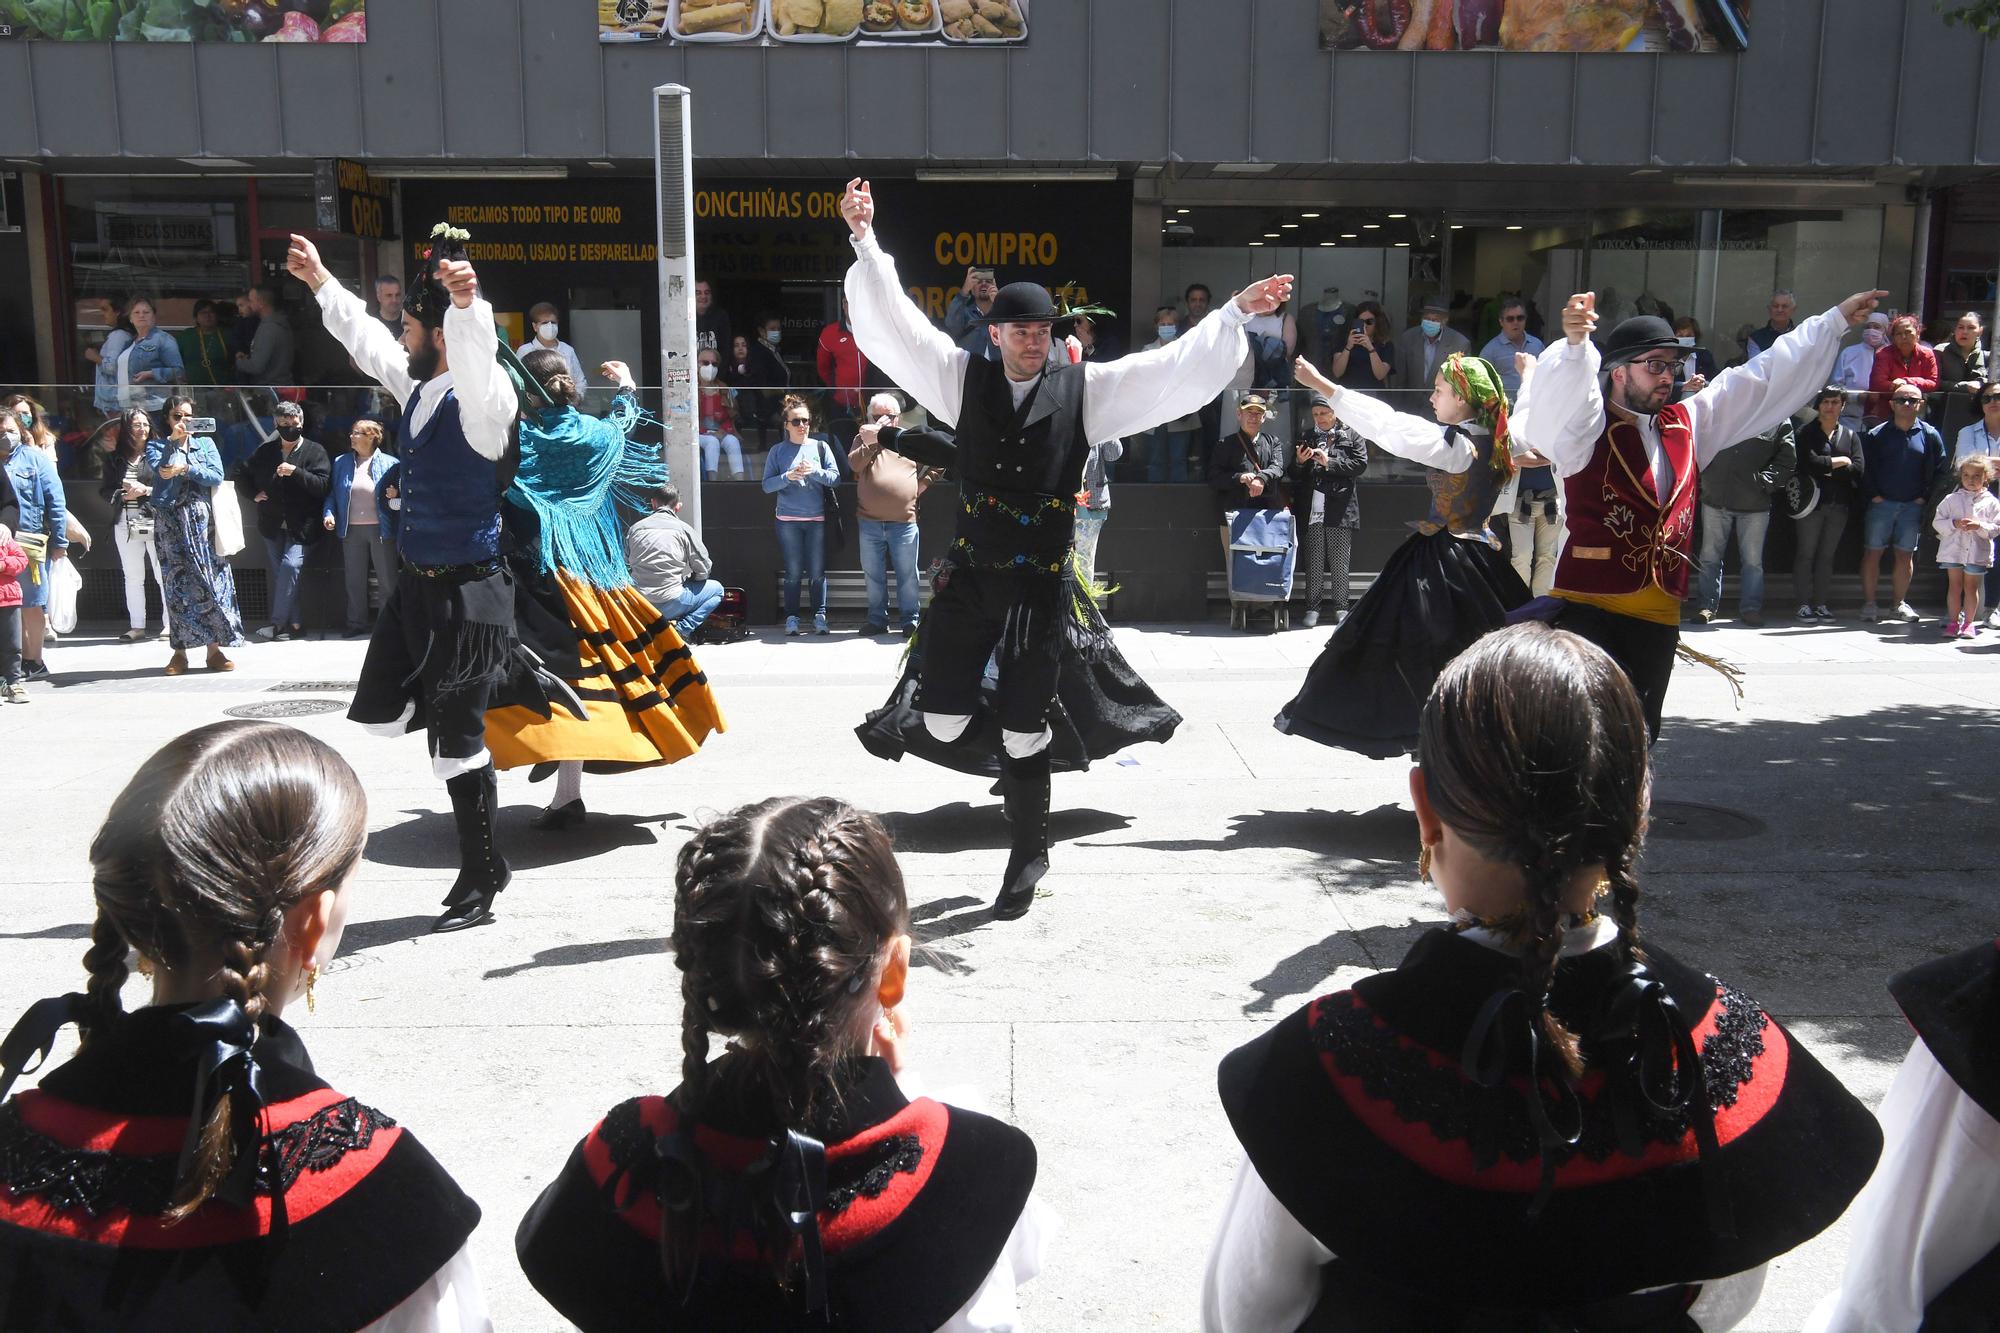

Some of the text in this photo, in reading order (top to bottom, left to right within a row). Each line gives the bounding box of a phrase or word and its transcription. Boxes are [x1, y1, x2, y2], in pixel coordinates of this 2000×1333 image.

[352, 195, 383, 238] ORO
[448, 206, 622, 224] MERCAMOS TODO TIPO DE OURO
[529, 243, 567, 261] USADO
[569, 243, 577, 261] E
[934, 232, 1058, 266] COMPRO
